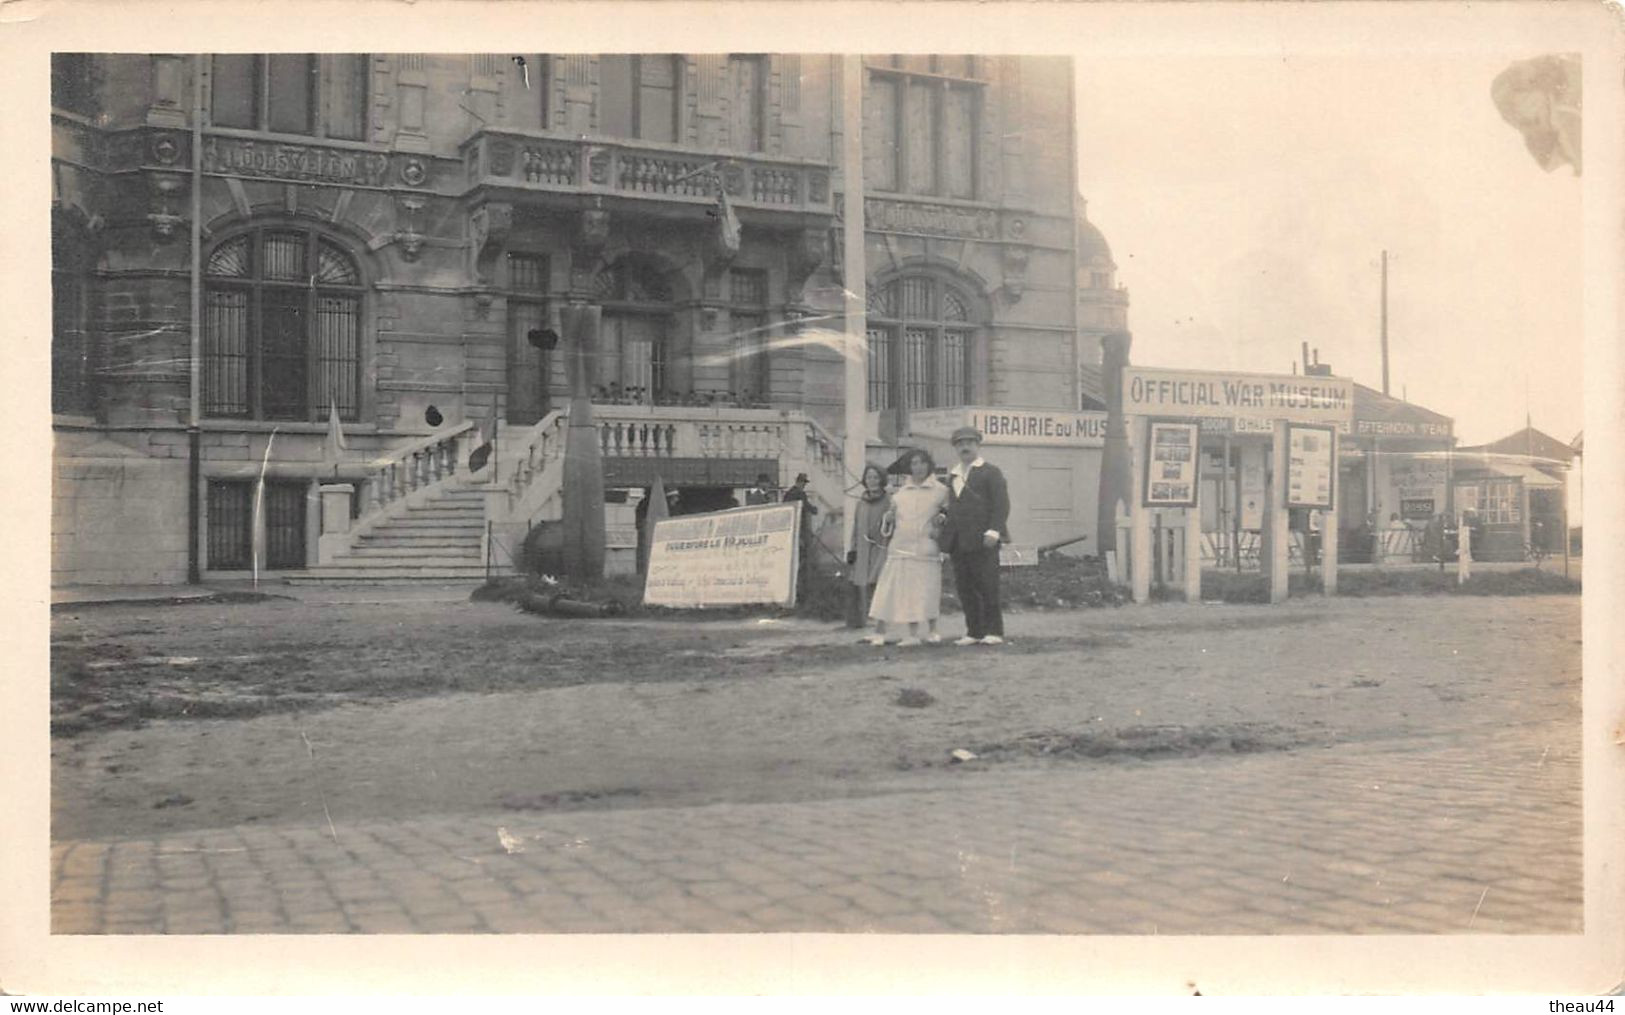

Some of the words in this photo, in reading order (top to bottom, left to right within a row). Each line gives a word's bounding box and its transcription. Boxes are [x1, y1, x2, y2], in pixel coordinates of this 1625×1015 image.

[1131, 376, 1219, 406] OFFICIAL
[1223, 380, 1264, 408] WAR
[1269, 382, 1347, 411] MUSEUM
[973, 414, 1054, 437] LIBRAIRIE
